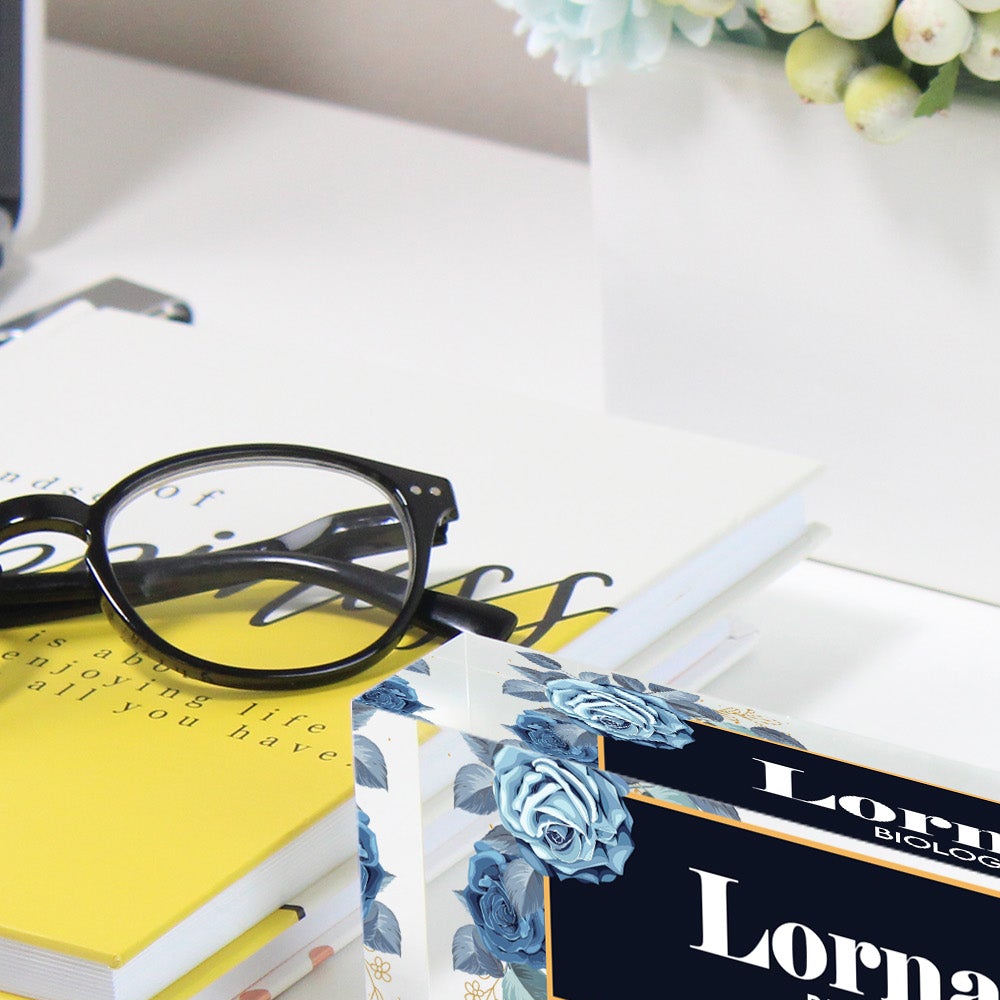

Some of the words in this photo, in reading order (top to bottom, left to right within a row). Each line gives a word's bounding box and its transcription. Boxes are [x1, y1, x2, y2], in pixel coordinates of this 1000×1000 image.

[25, 629, 67, 648] is
[1, 650, 212, 709] enjoying
[238, 702, 327, 734] life
[27, 680, 97, 702] all
[112, 702, 200, 728] you
[226, 724, 352, 767] have.
